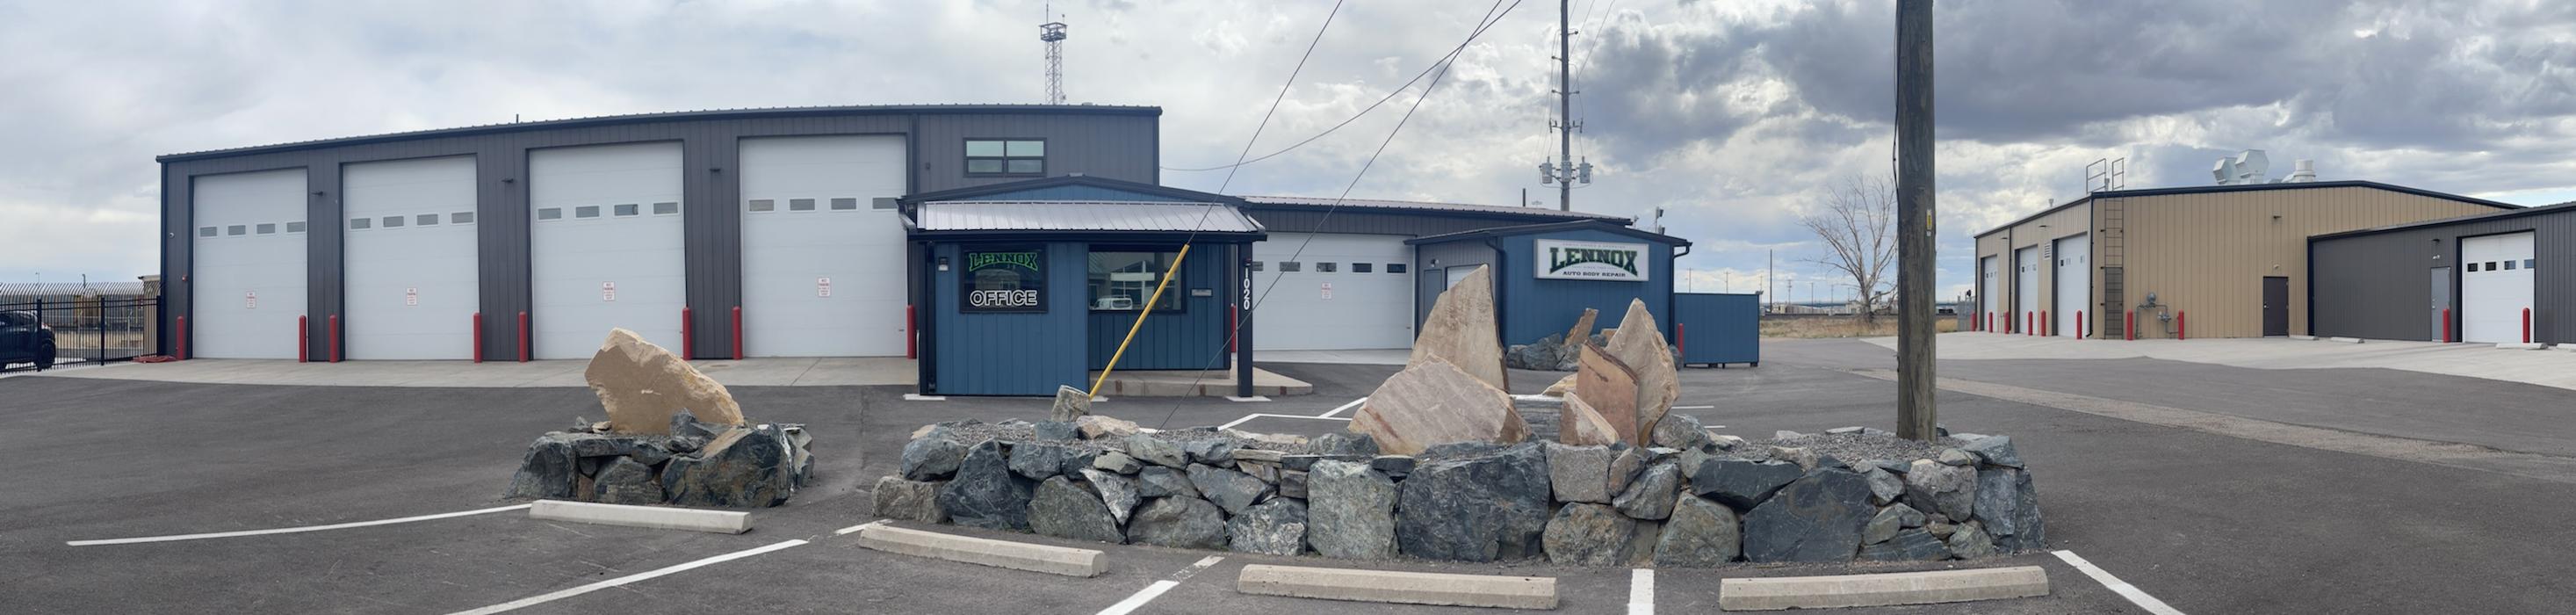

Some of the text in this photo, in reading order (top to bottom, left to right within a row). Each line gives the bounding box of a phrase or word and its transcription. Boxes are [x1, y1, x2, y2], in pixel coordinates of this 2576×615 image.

[970, 252, 1038, 271] LENNOX
[1549, 247, 1638, 277] LENNOX
[970, 289, 1037, 307] OFFICE
